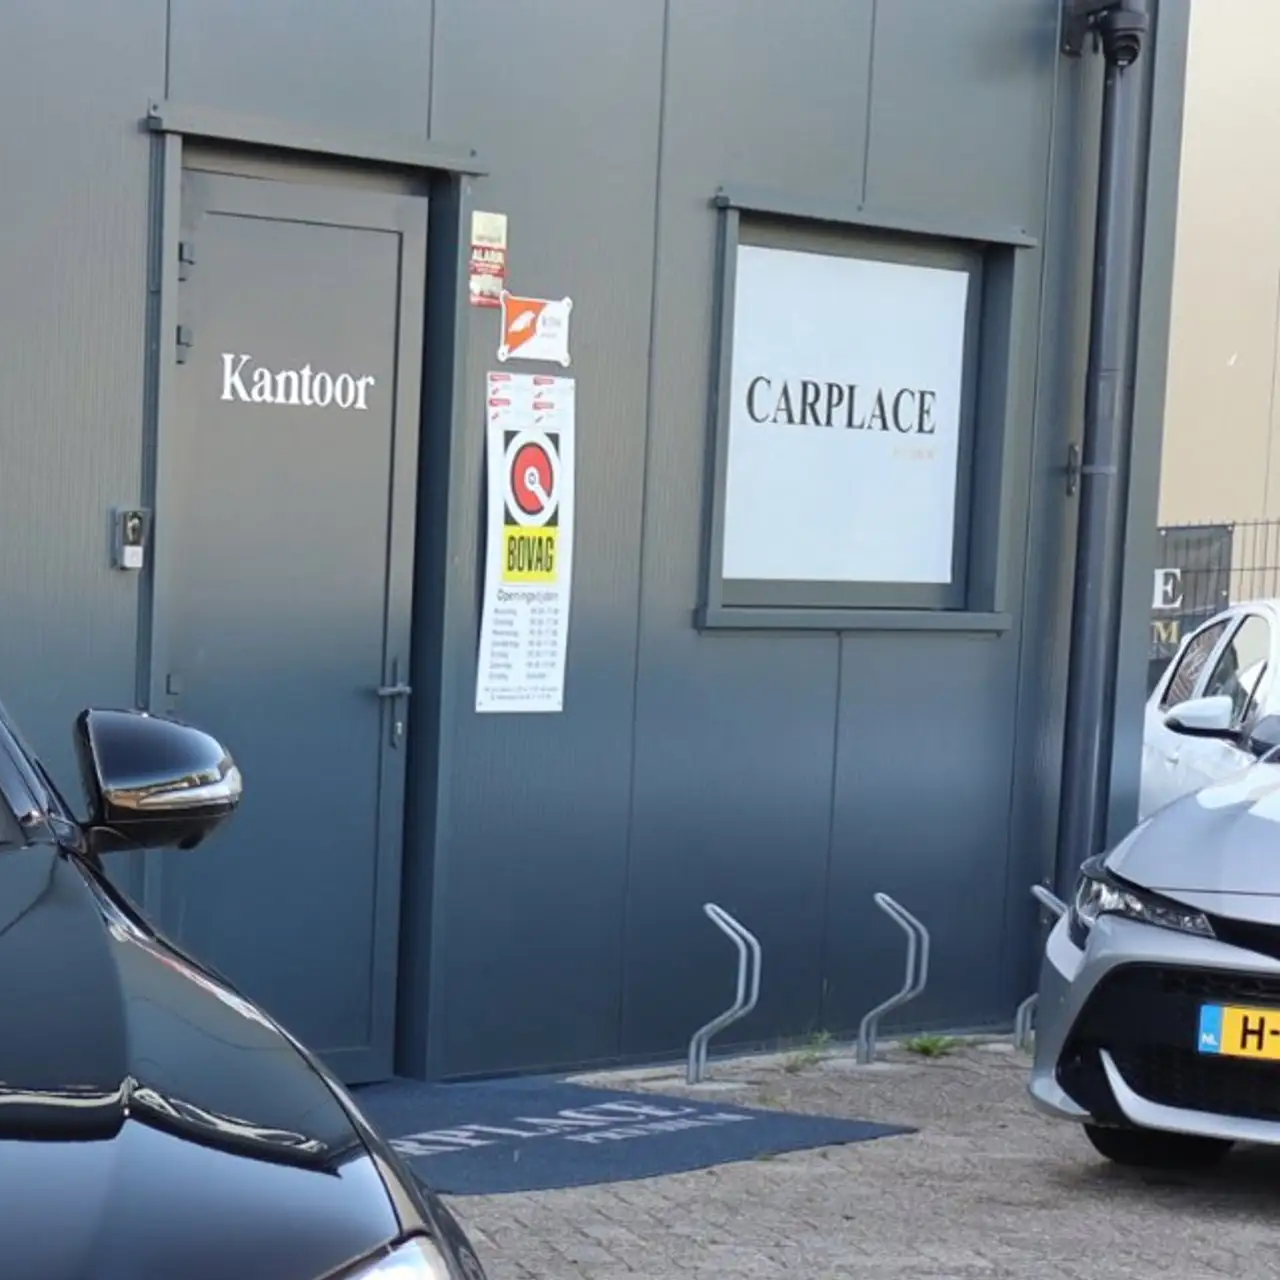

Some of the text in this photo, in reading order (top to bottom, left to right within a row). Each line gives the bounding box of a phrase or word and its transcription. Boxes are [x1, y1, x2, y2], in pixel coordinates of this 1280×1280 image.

[221, 353, 375, 409] Kantoor
[746, 376, 937, 434] CARPLACE
[507, 534, 555, 573] BOVAG
[1202, 1033, 1219, 1046] NL
